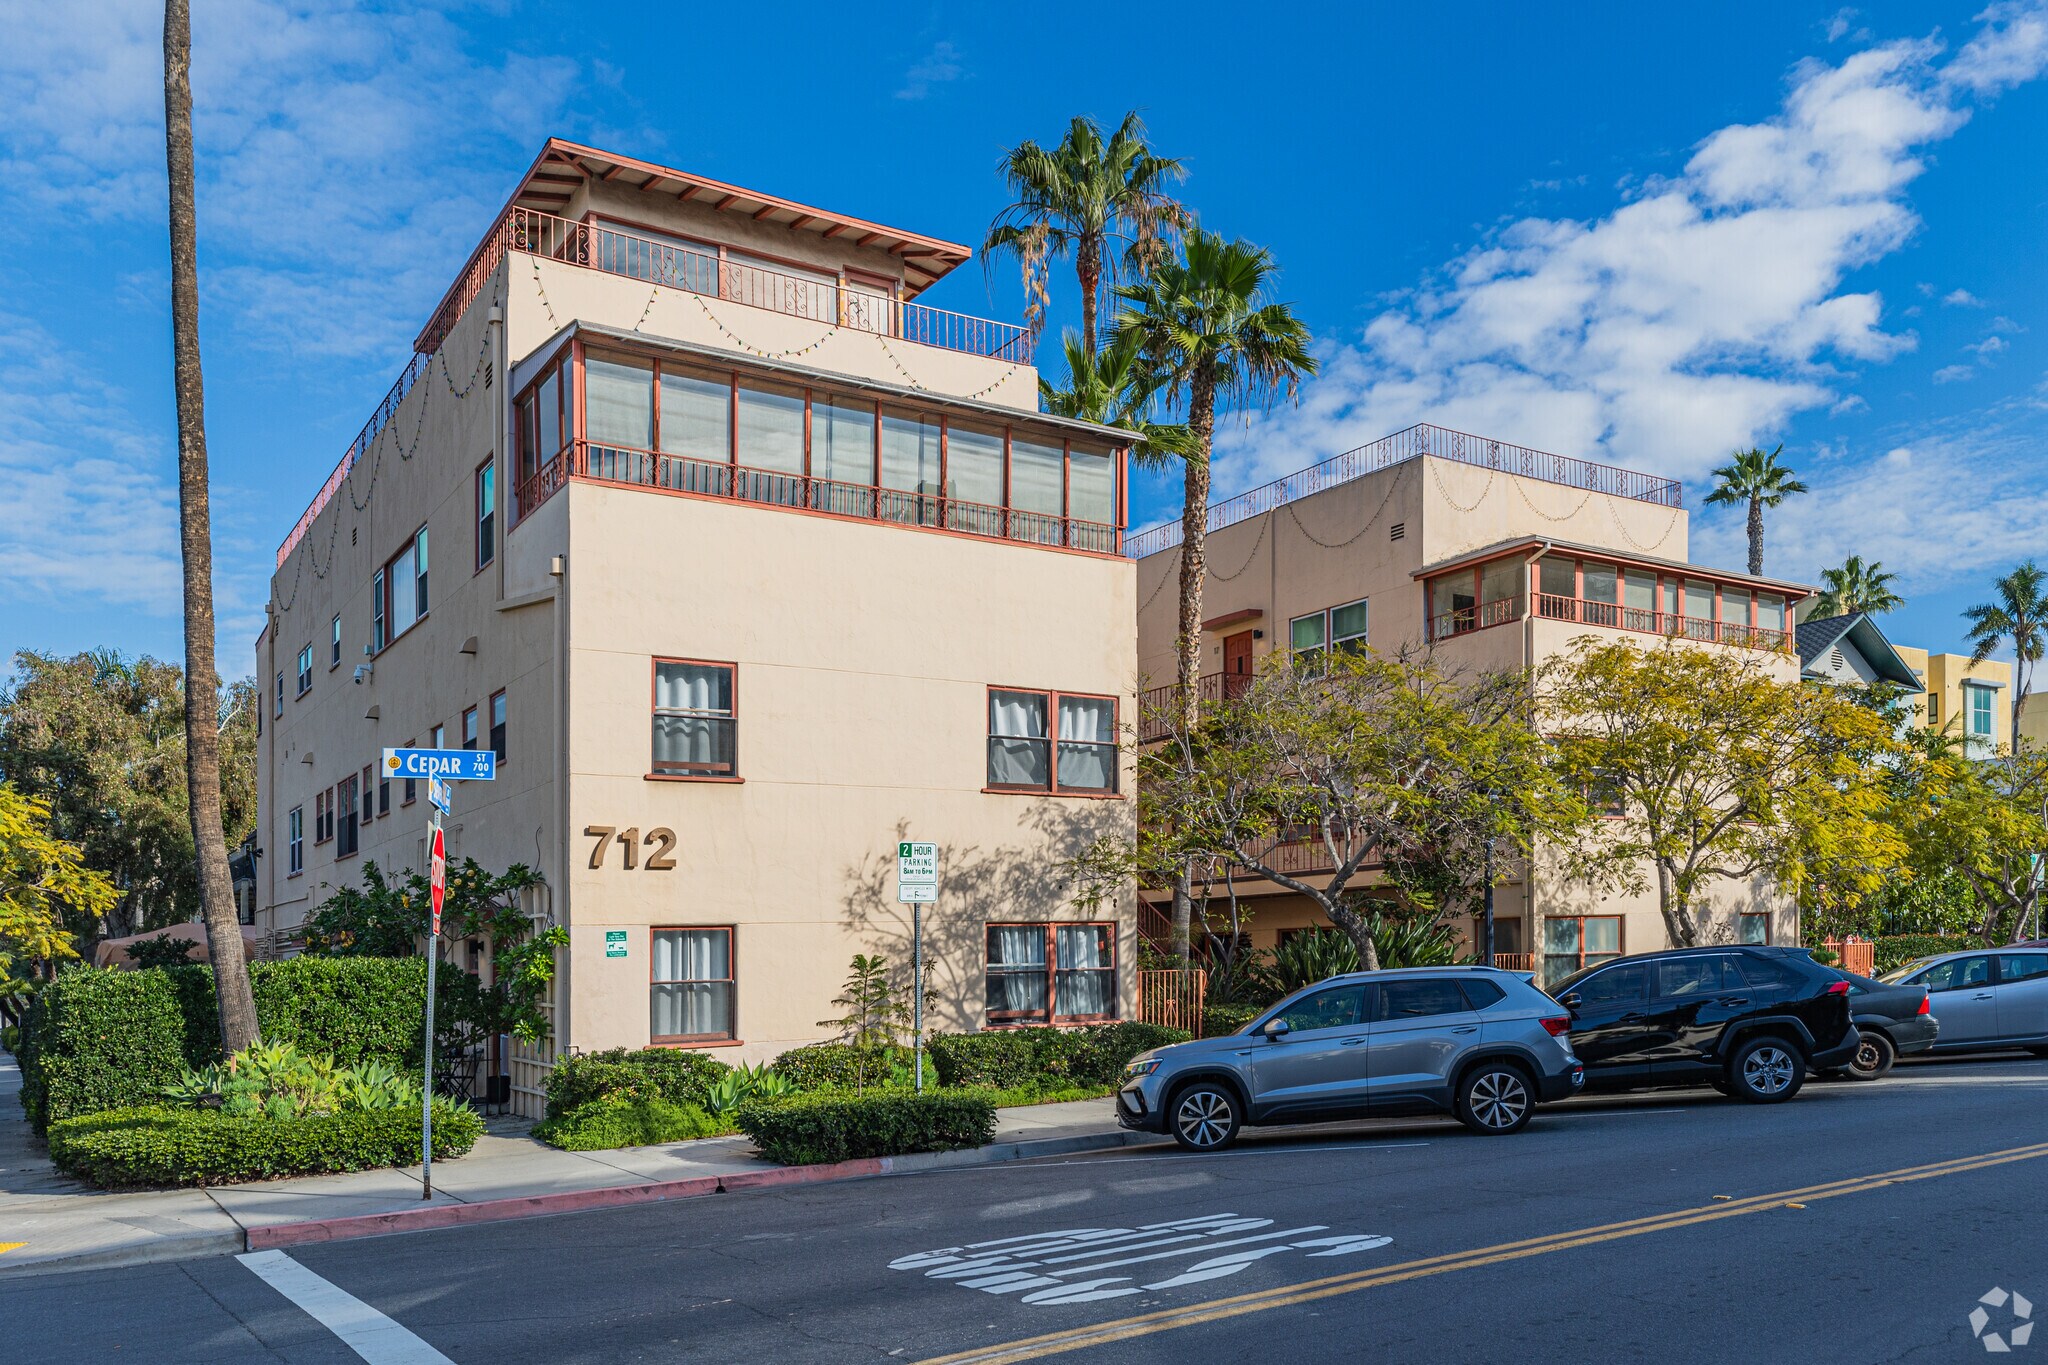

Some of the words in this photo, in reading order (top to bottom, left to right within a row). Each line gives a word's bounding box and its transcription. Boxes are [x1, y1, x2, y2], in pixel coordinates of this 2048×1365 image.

[406, 753, 461, 774] CEDAR
[476, 753, 487, 762] ST
[473, 763, 489, 772] 700
[586, 825, 677, 868] 712
[903, 844, 909, 856] 2
[914, 846, 932, 855] HOUR
[904, 858, 932, 866] PARKING
[887, 1213, 1395, 1305] STOP
